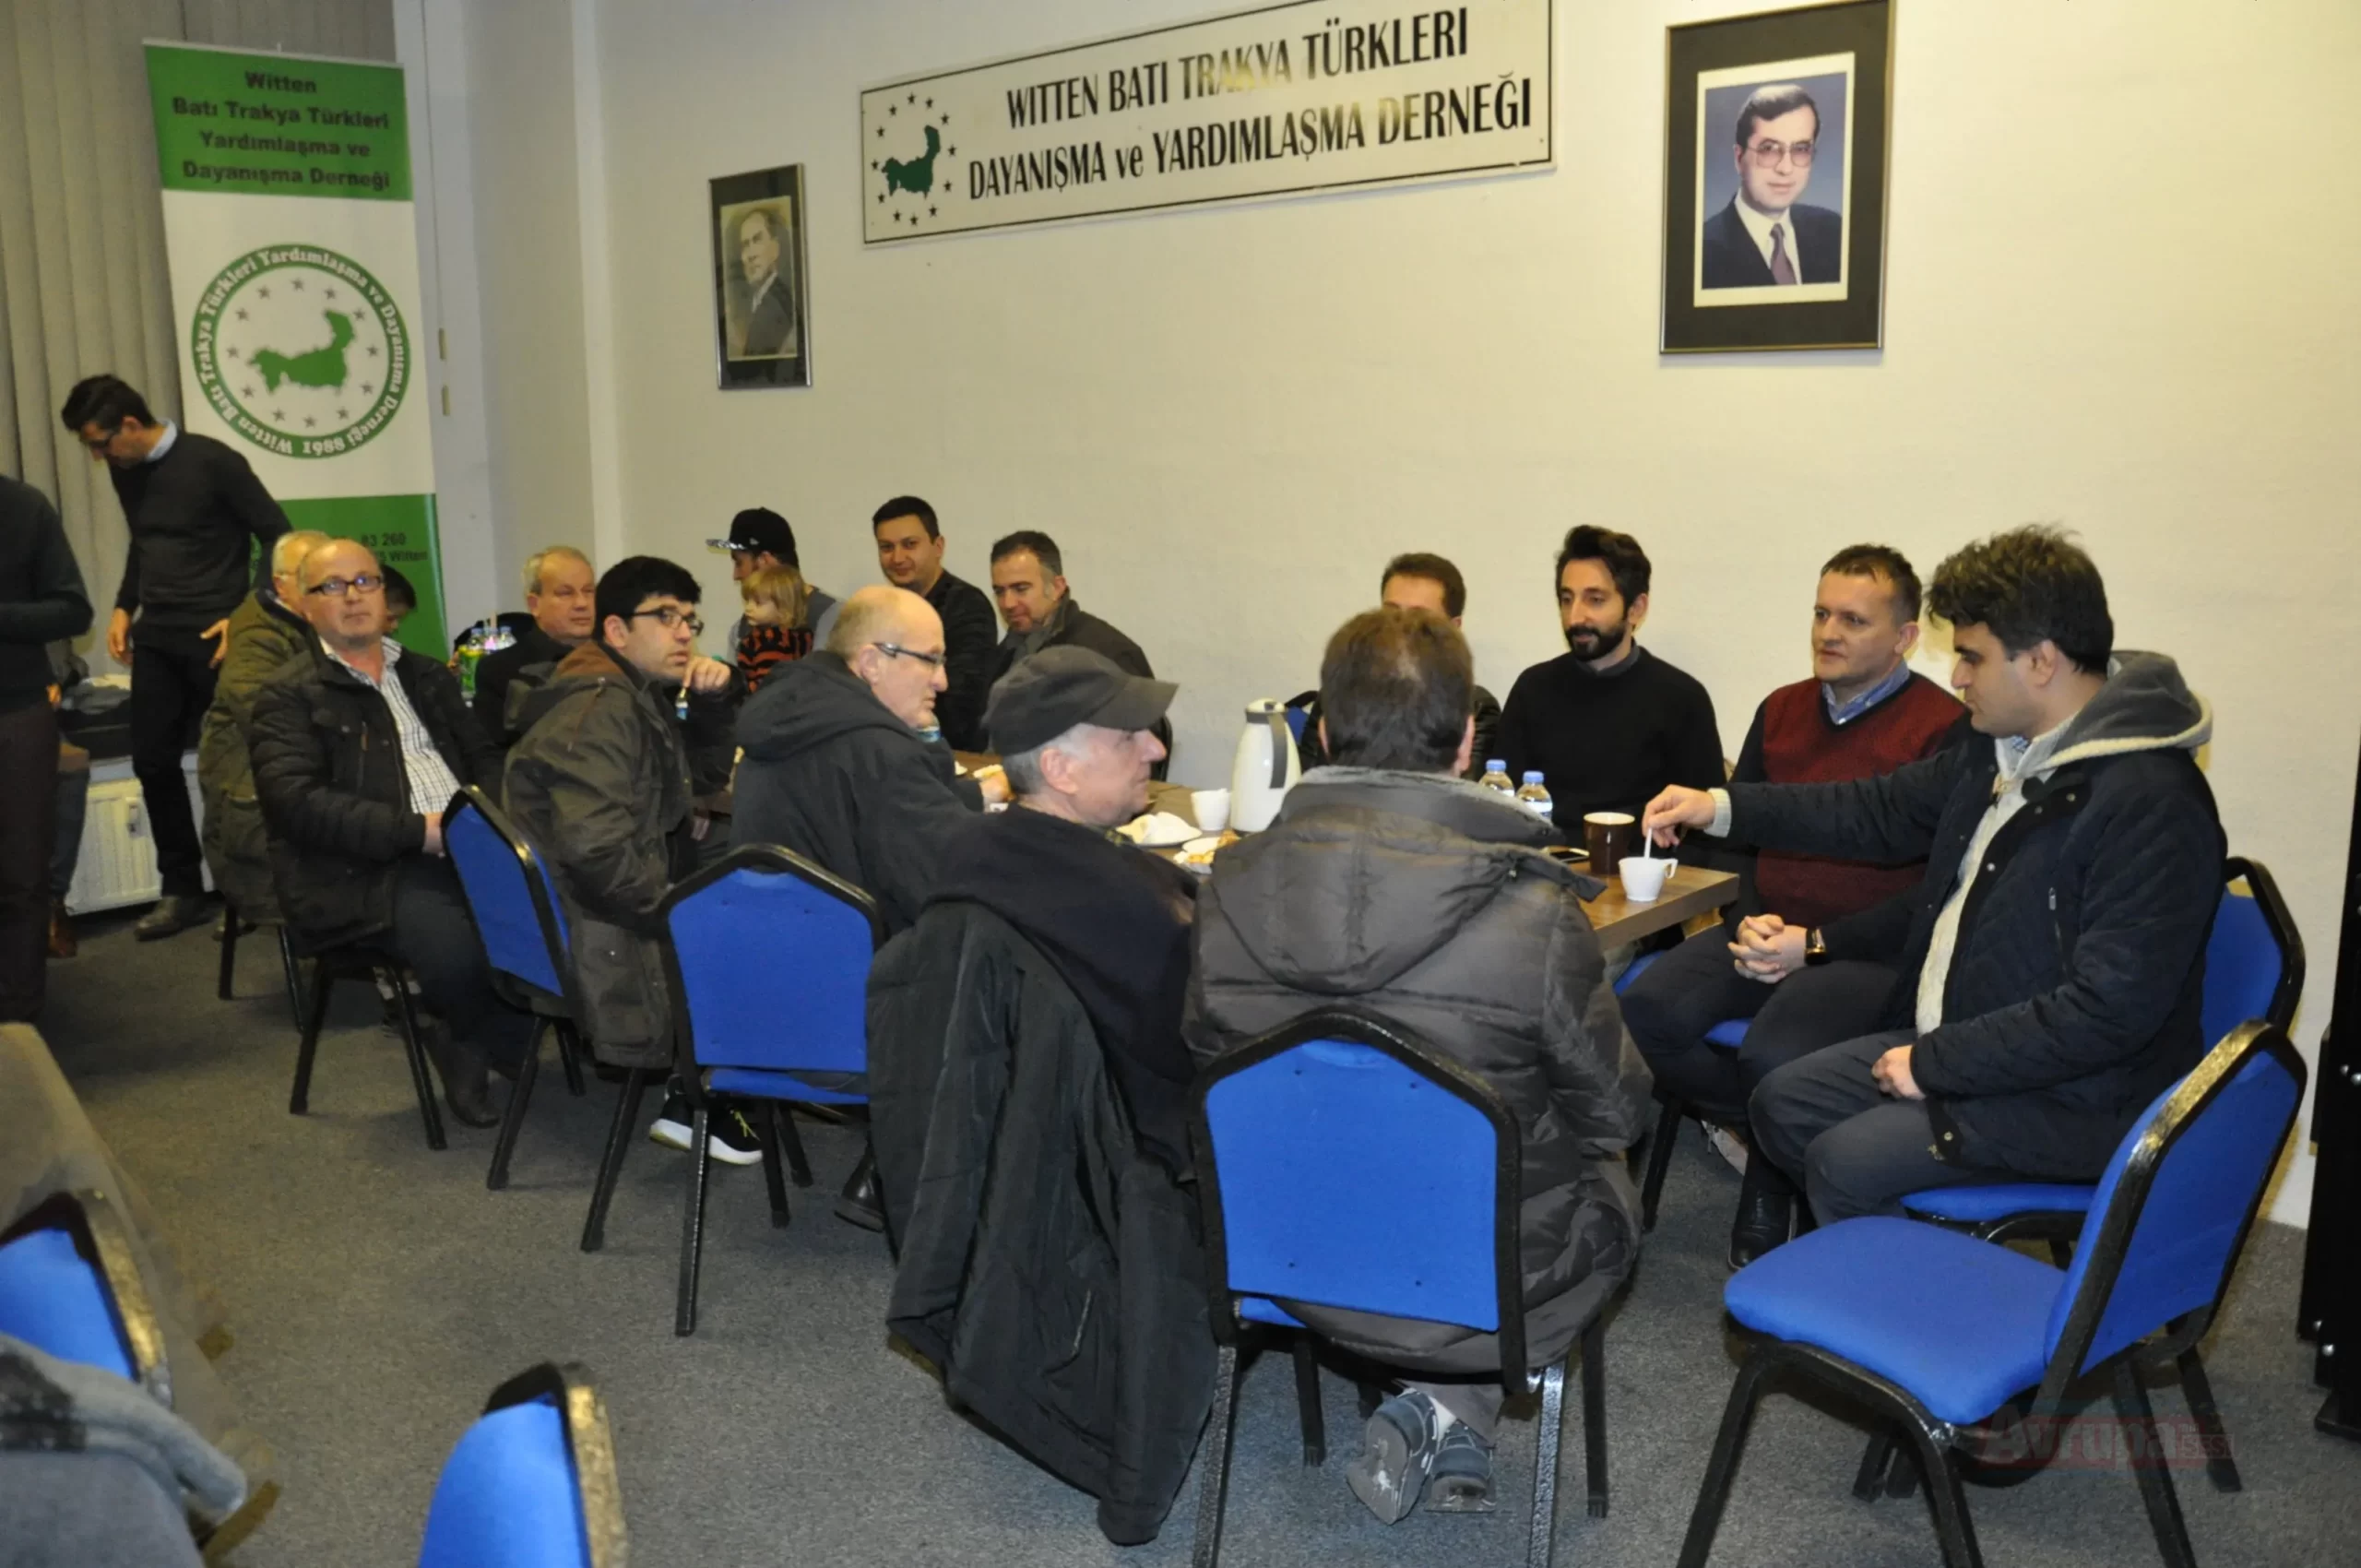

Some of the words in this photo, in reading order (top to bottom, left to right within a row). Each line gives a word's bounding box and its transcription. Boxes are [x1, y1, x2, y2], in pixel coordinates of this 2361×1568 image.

[244, 71, 317, 94] Witten
[1007, 74, 1098, 129] WITTEN
[1109, 61, 1169, 113] BATI
[1178, 39, 1292, 101] TRAKYA
[1302, 6, 1468, 80] TÜRKLERI
[172, 97, 219, 117] Batı
[224, 100, 301, 126] Trakya
[307, 106, 389, 130] Türkleri
[199, 130, 340, 158] Yardımlaşma
[347, 143, 371, 157] ve
[969, 141, 1107, 200] DAYANIŞMA
[1116, 146, 1144, 179] ve
[1153, 102, 1366, 173] YARDIMLAŞMA
[1378, 71, 1531, 146] DERNEĞI
[182, 160, 303, 185] Dayanışma
[310, 167, 390, 191] Derneği
[200, 257, 257, 315] Türkleri
[256, 247, 368, 289] Yardımlaşma
[369, 288, 385, 304] ve
[196, 319, 216, 384] Trakya
[381, 304, 405, 393] Dayanışma
[210, 386, 239, 424] Batı
[348, 395, 398, 445] Derneği
[238, 418, 293, 454] Witten
